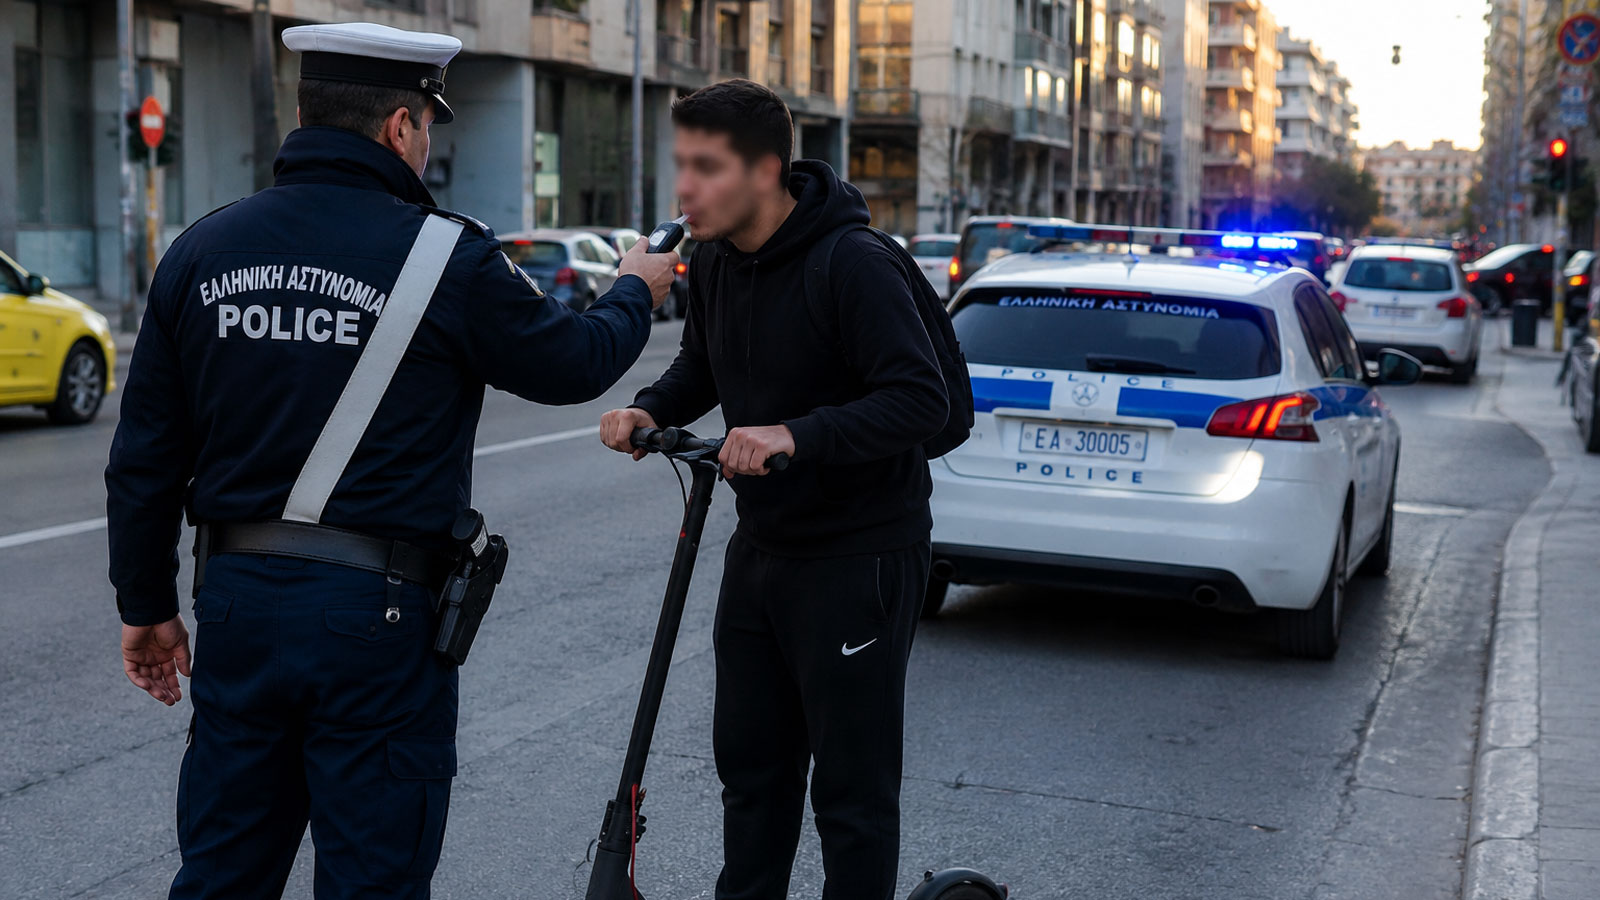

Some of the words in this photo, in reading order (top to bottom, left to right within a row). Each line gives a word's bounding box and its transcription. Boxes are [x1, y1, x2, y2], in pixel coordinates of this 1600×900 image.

[286, 265, 386, 317] ΑΣΤΥΝΟΜΙΑ
[1101, 299, 1220, 319] ΑΣΤΥΝΟΜΙΑ
[218, 304, 360, 345] POLICE
[1001, 368, 1174, 388] POLICE
[1075, 430, 1131, 455] 30005
[1016, 462, 1143, 483] POLICE
